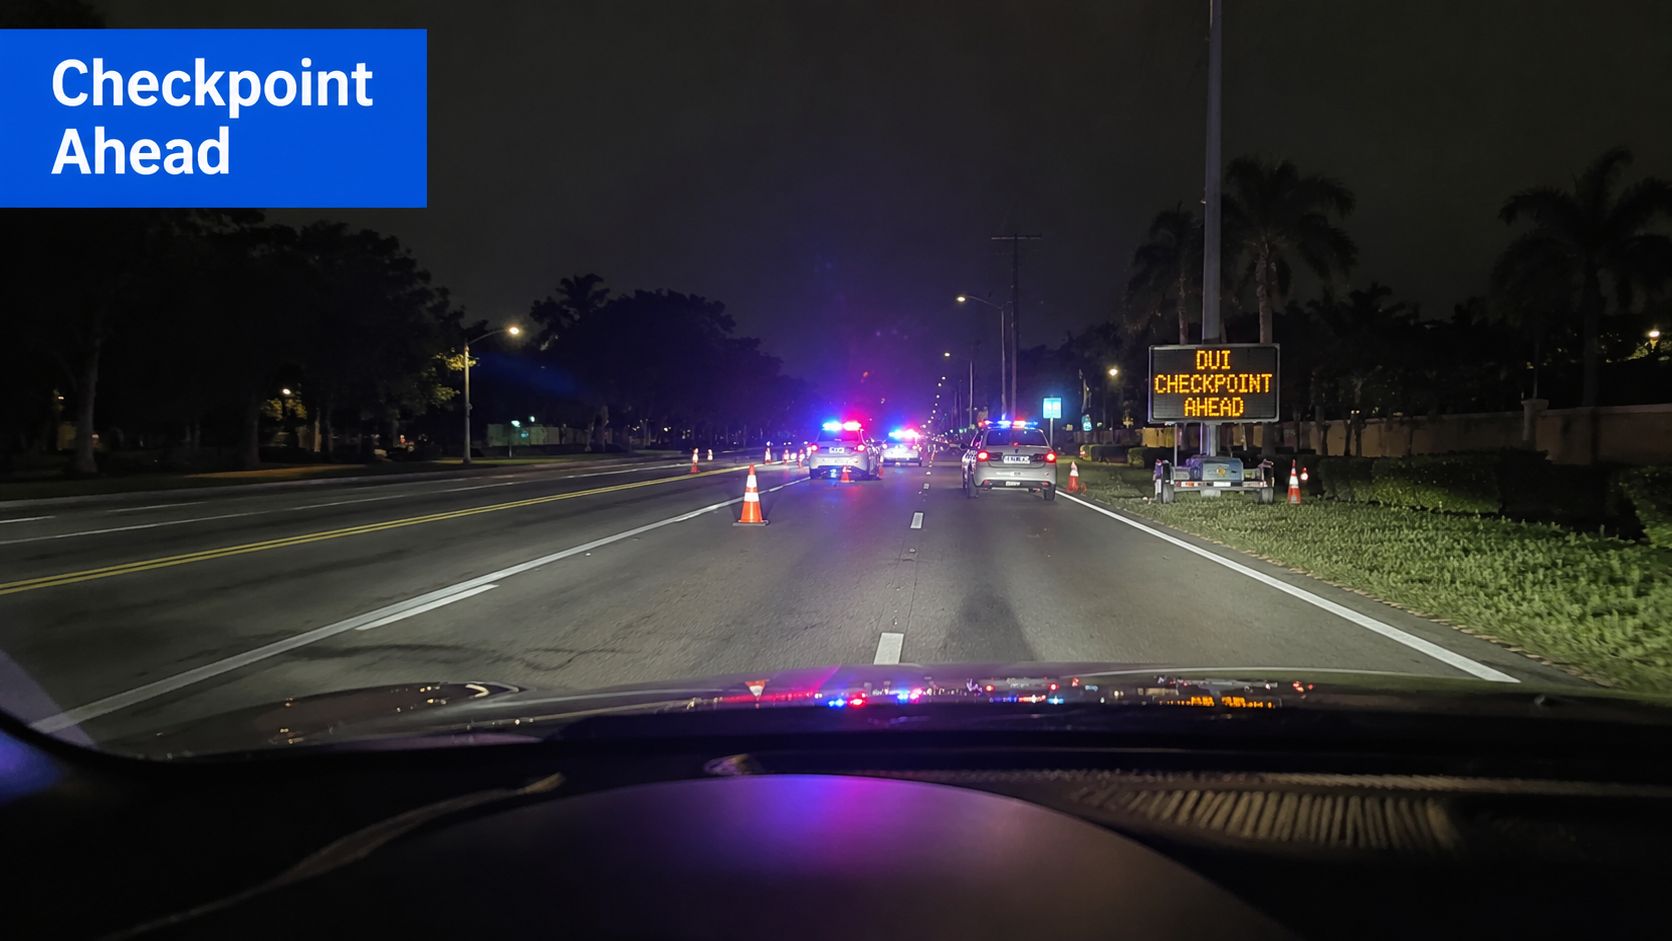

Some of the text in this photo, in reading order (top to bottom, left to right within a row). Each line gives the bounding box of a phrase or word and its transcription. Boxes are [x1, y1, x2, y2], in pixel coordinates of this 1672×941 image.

[1196, 350, 1231, 370] DUI
[1154, 374, 1272, 394] CHECKPOINT
[1184, 397, 1244, 418] AHEAD
